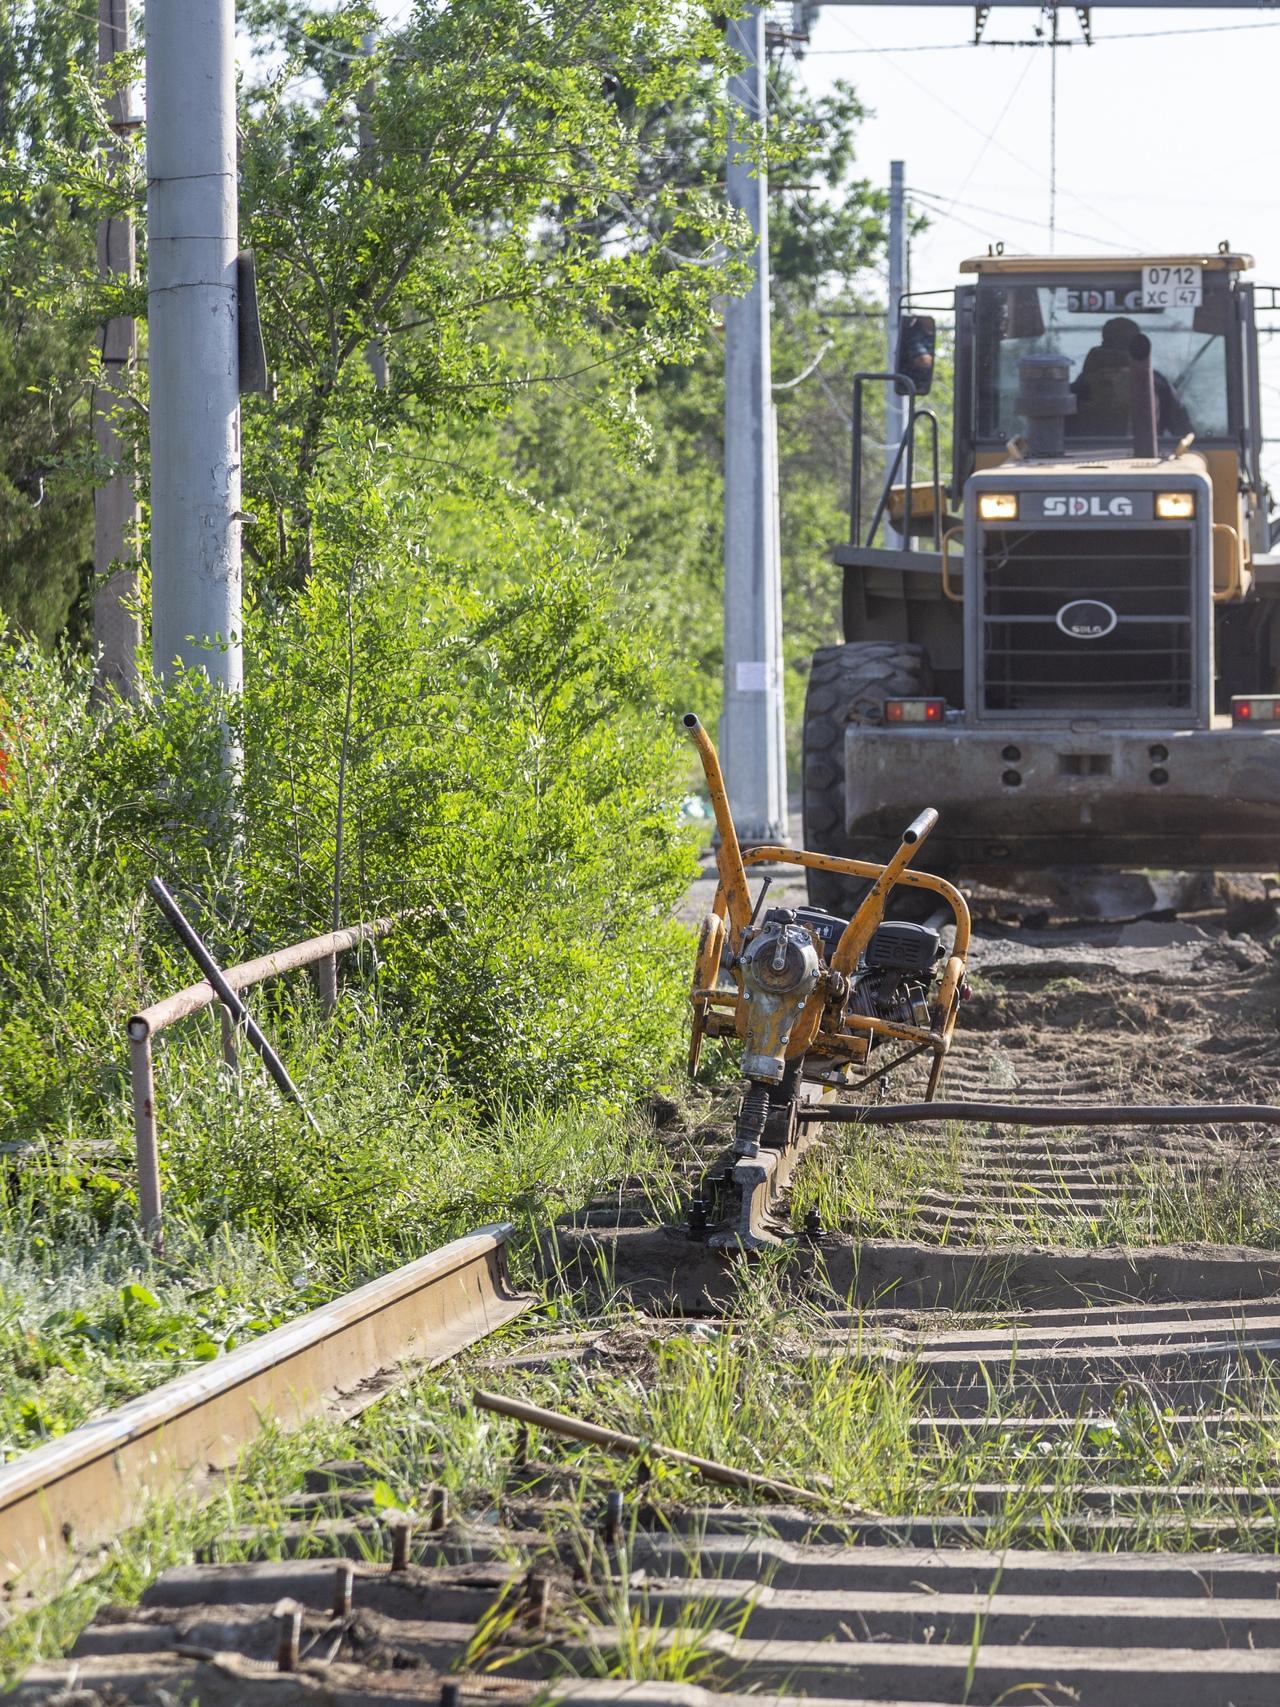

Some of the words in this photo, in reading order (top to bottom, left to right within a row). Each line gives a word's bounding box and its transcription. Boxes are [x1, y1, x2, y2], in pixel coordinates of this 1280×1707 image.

[1148, 267, 1194, 285] 0712
[1179, 290, 1197, 304] 47
[1042, 496, 1133, 517] SDLG
